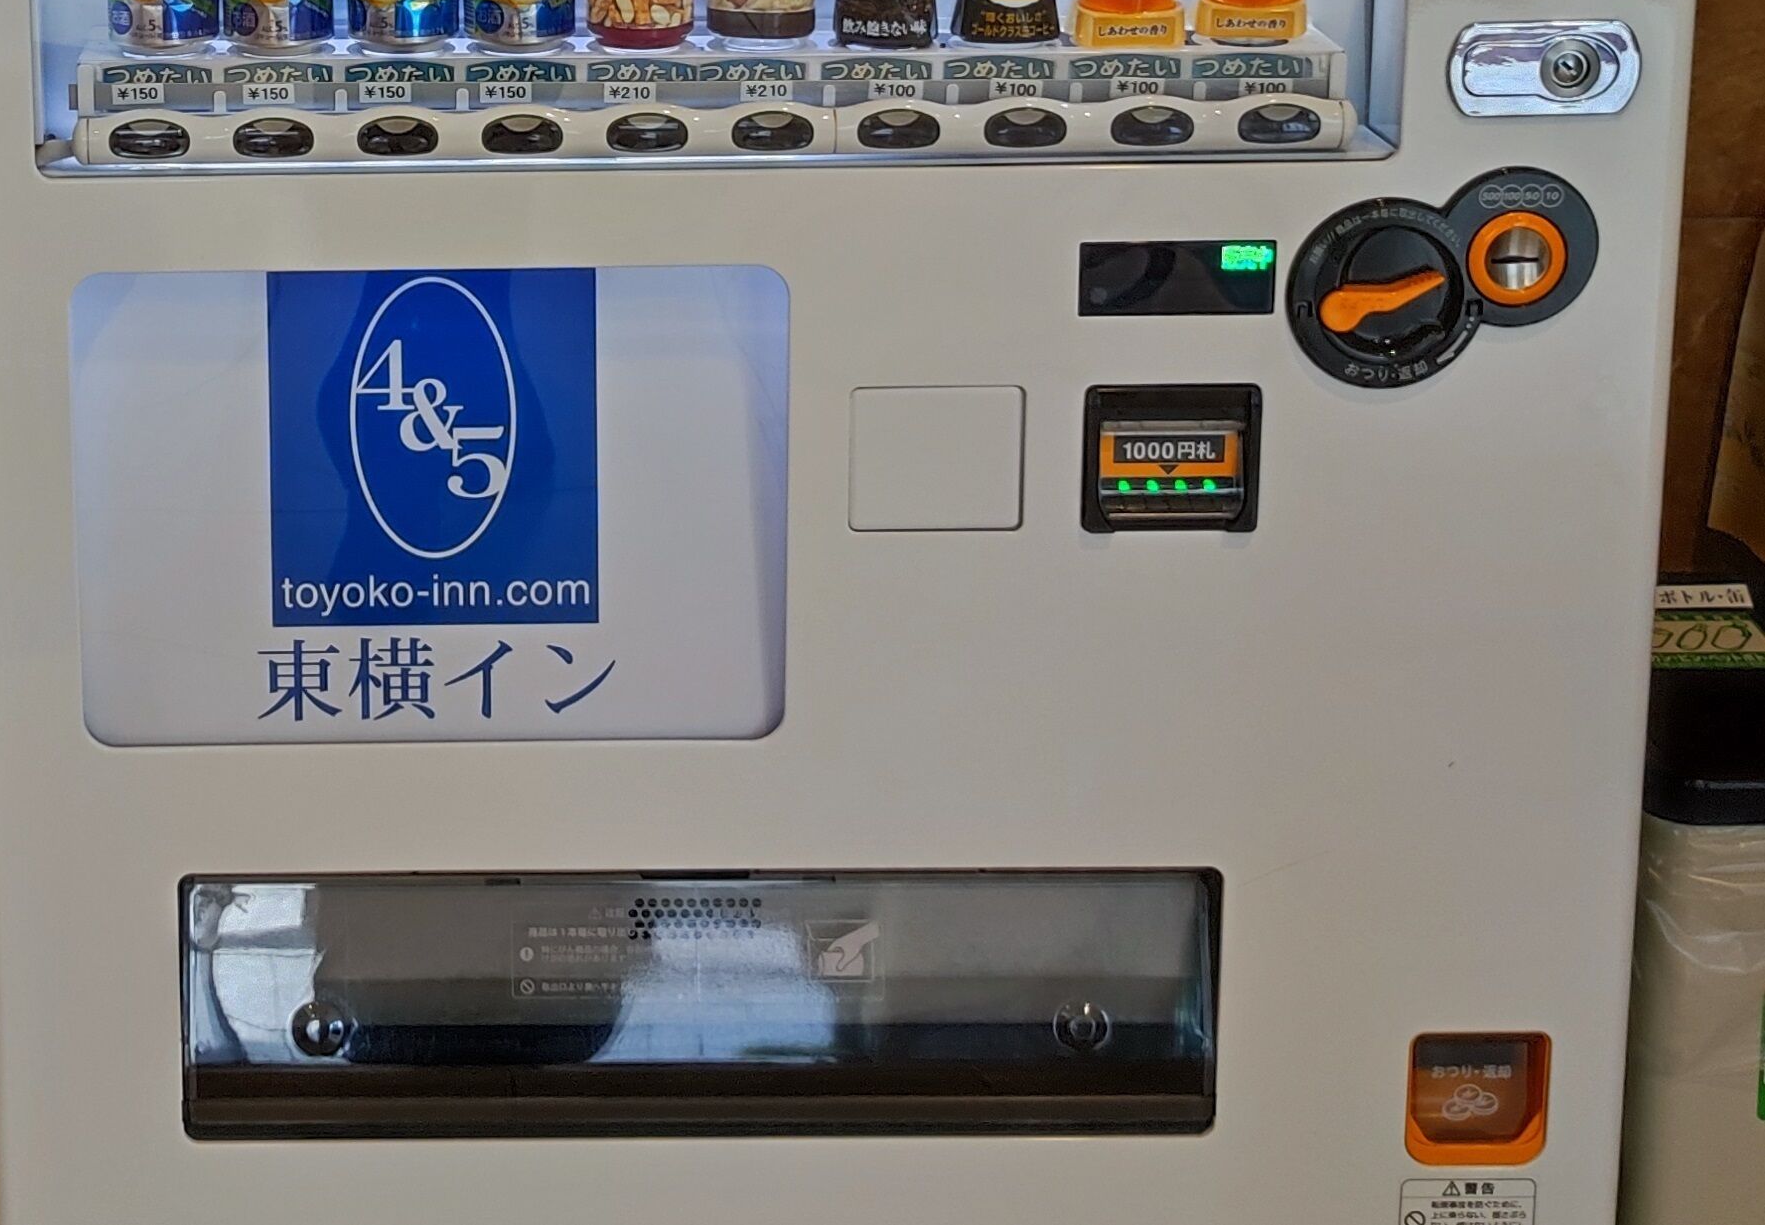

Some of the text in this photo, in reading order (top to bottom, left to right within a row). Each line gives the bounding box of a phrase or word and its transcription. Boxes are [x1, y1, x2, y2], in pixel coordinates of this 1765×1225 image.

[1097, 25, 1168, 37] しあわせの香り
[1215, 16, 1287, 30] しあわせの香り
[469, 63, 573, 82] つめたい
[590, 62, 694, 82] つめたい
[700, 61, 803, 81] つめたい
[824, 61, 928, 81] つめたい
[945, 59, 1051, 78] つめたい
[1072, 57, 1178, 77] つめたい
[1195, 55, 1301, 75] つめたい
[107, 67, 208, 83] つめたい
[227, 66, 330, 83] つめたい
[349, 65, 451, 82] つめたい
[117, 87, 159, 100] ¥150
[247, 87, 290, 100] ¥150
[363, 86, 406, 99] ¥150
[485, 86, 527, 99] ¥150
[609, 86, 651, 99] ¥210
[745, 84, 787, 98] ¥210
[873, 82, 916, 97] ¥100
[994, 81, 1037, 97] ¥100
[1116, 79, 1159, 95] ¥100
[1243, 81, 1286, 95] ¥100
[1481, 192, 1501, 202] 500
[1524, 191, 1540, 201] 50
[1546, 191, 1560, 201] 10
[355, 339, 506, 498] 4&5
[1121, 440, 1216, 461] 1000円札
[281, 573, 591, 617] toyoko-inn.com
[257, 636, 617, 722] 東横イン
[1464, 1182, 1496, 1196] 警告
